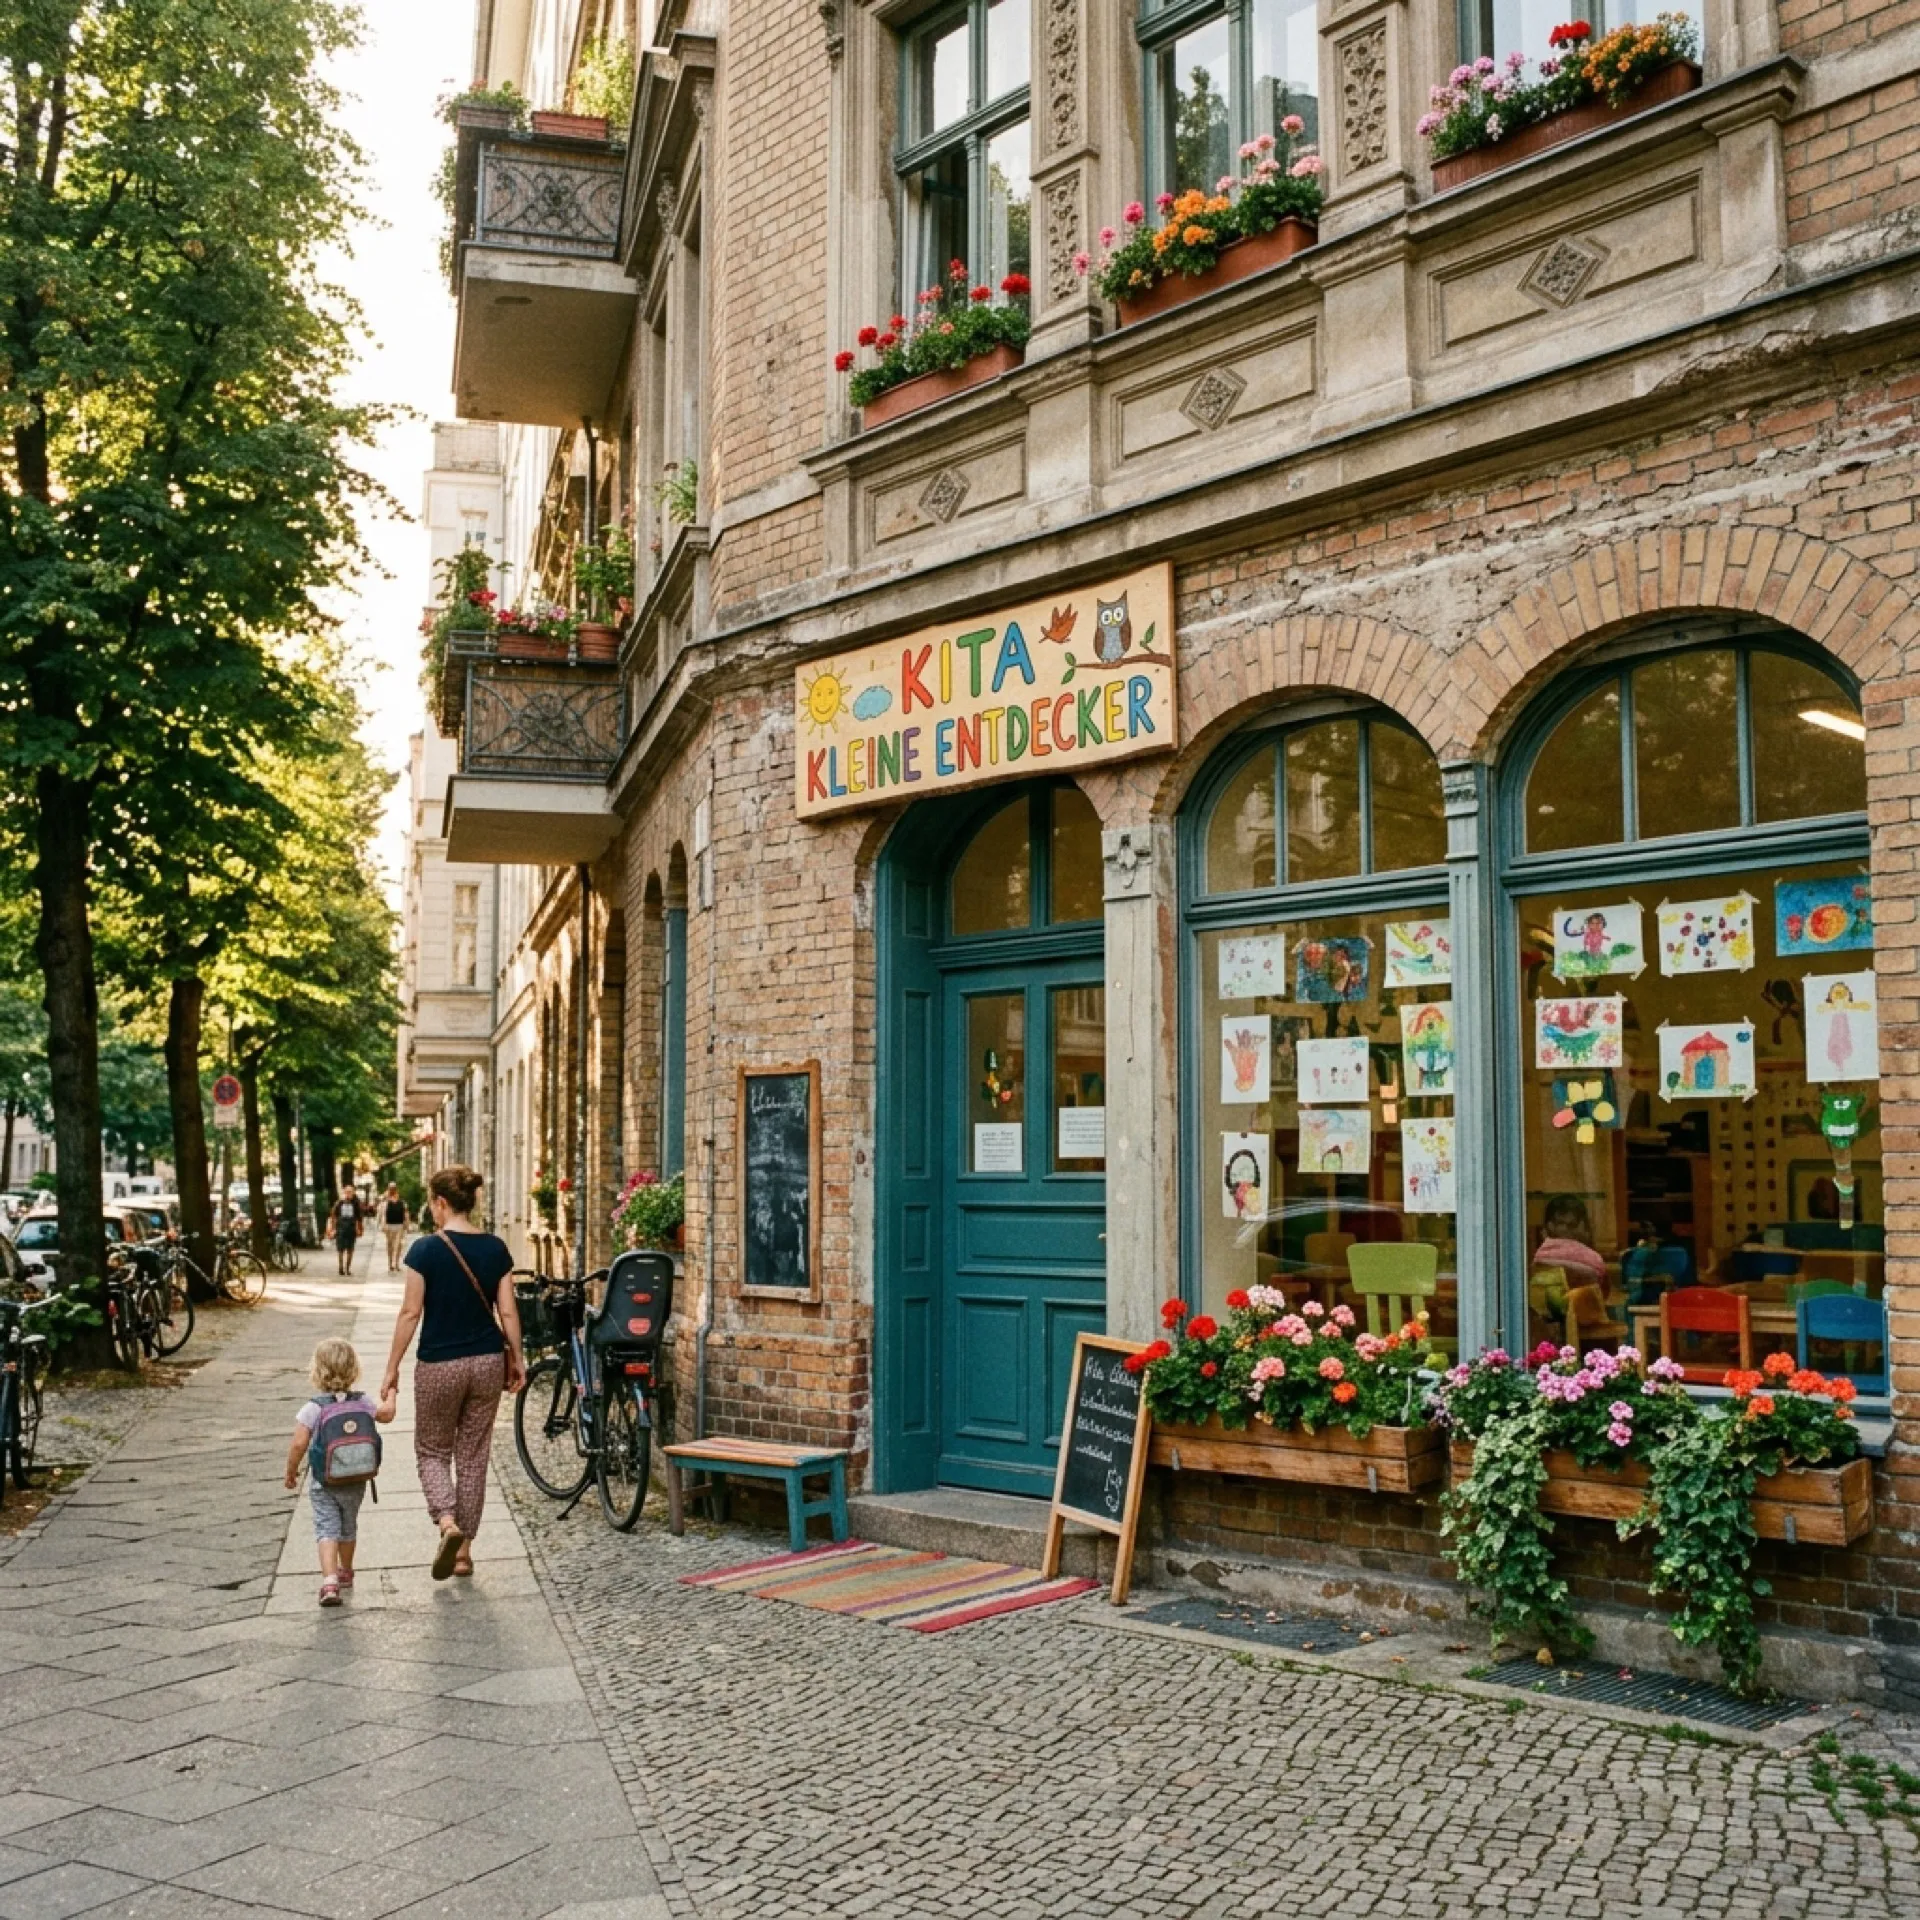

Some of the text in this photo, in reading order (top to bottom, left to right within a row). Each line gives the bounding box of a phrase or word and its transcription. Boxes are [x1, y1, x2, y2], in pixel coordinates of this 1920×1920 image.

[902, 621, 1036, 714] KITA
[807, 675, 1156, 802] KLEINE ENTDECKER
